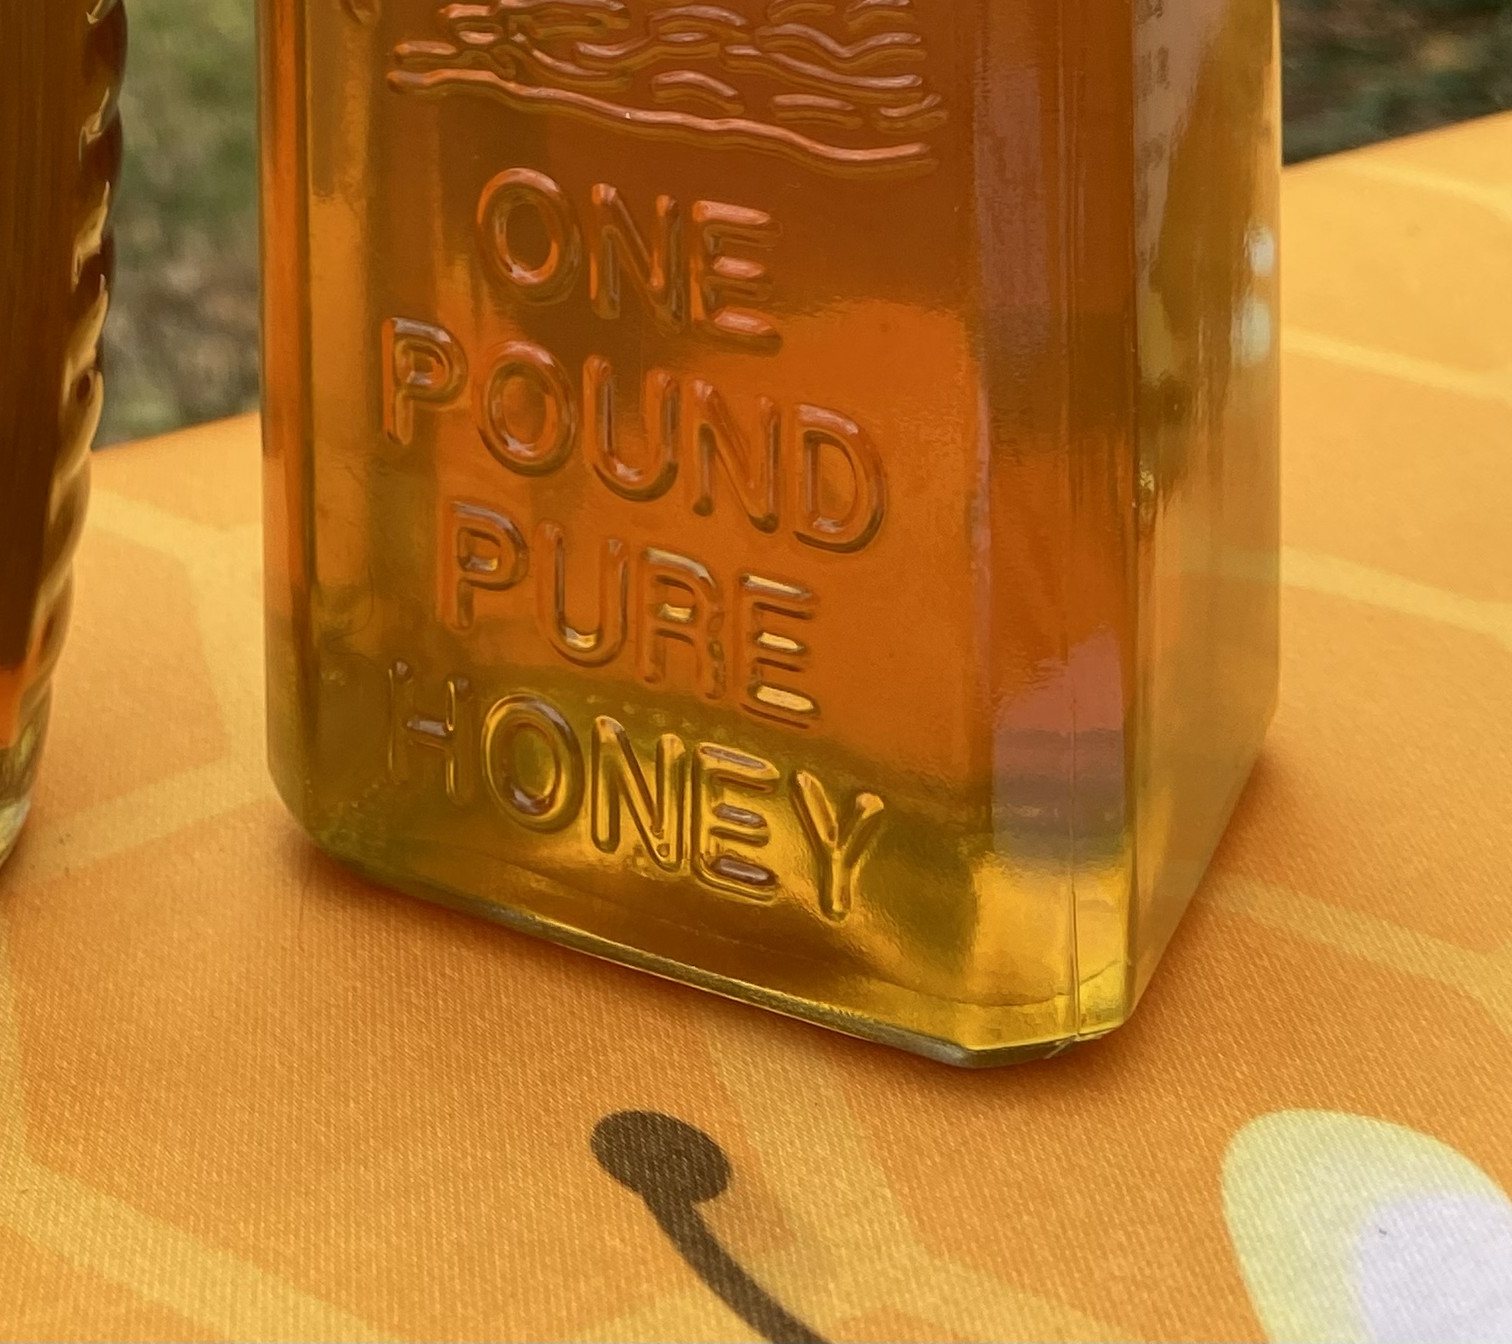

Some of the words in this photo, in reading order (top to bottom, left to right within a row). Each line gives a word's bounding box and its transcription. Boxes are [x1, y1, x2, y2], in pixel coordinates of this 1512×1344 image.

[474, 165, 784, 358] ONE
[380, 315, 889, 555] POUND
[439, 499, 822, 731] PURE
[385, 658, 887, 924] HONEY
